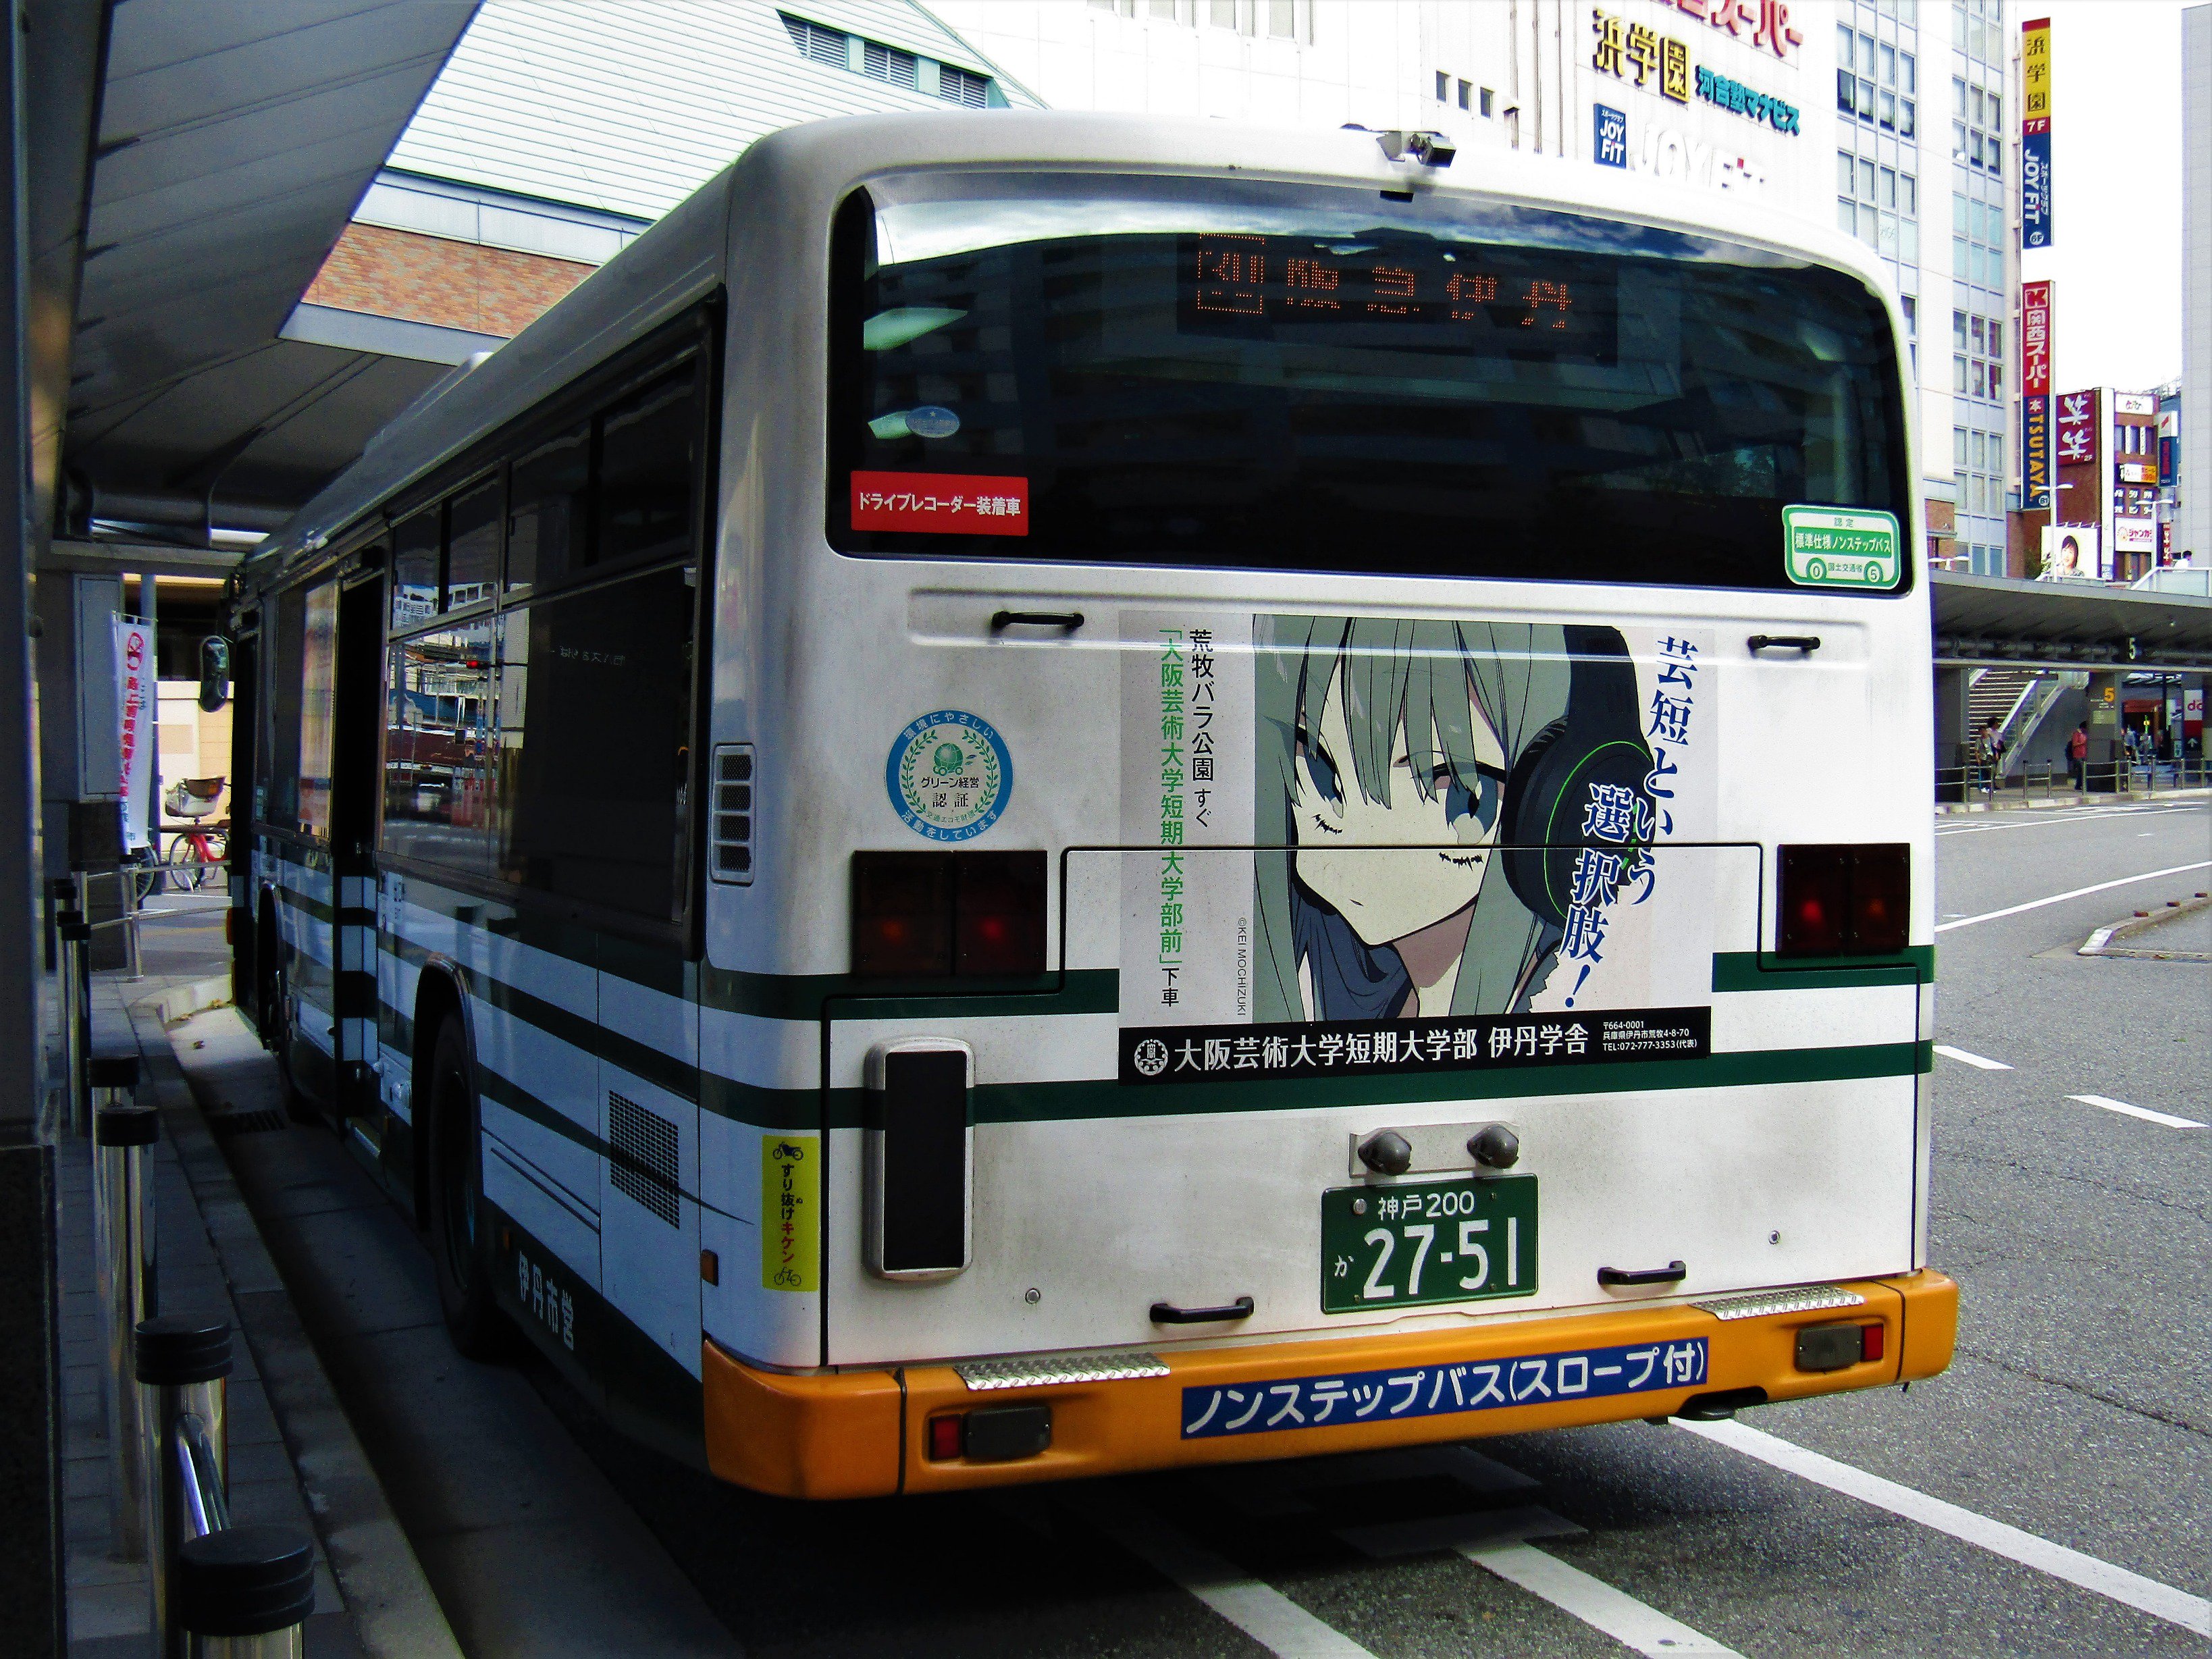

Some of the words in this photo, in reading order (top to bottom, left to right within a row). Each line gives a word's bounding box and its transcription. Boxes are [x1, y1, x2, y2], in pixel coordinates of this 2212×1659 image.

[1593, 7, 1690, 103] 浜学園
[2026, 36, 2045, 112] 浜学園
[1695, 65, 1800, 135] 河合塾マナビス
[1600, 120, 1625, 142] JOY
[2027, 120, 2045, 133] 7F
[2026, 310, 2047, 388] 関西スーパー
[2030, 400, 2041, 411] 本
[2058, 395, 2090, 460] 笑笑
[2029, 414, 2045, 498] TSUTAYA
[860, 492, 1021, 516] ドライブレコーダー装着車
[1834, 517, 1854, 528] 認定
[2129, 529, 2152, 537] ジャンカ
[1795, 532, 1892, 554] 標準仕様ノンステップバス
[1814, 565, 1820, 577] 0
[1870, 570, 1877, 581] 5
[2129, 637, 2136, 660] 5
[1189, 629, 1214, 781] 荒牧バラ公園
[2104, 687, 2115, 702] 5
[903, 712, 993, 740] 環境にやさしい
[921, 777, 979, 789] グリーン経営
[1626, 635, 1699, 906] 芸短という
[932, 792, 968, 808] 認証
[1194, 788, 1212, 828] すぐ
[901, 810, 998, 840] 活動をしています
[1237, 949, 1246, 1016] MOCHIZUKI
[1174, 1029, 1478, 1072] 大阪芸術大学短期大学部
[1488, 1022, 1589, 1058] 伊丹学舎
[1603, 1028, 1689, 1041] 兵庫県伊丹市荒牧4-8-70
[1377, 1194, 1422, 1220] 神戸
[1426, 1190, 1475, 1217] 200
[1334, 1255, 1354, 1278] か
[1363, 1217, 1517, 1299] 27-51
[1186, 1341, 1704, 1434] ノンステップバス(スロープ付)
